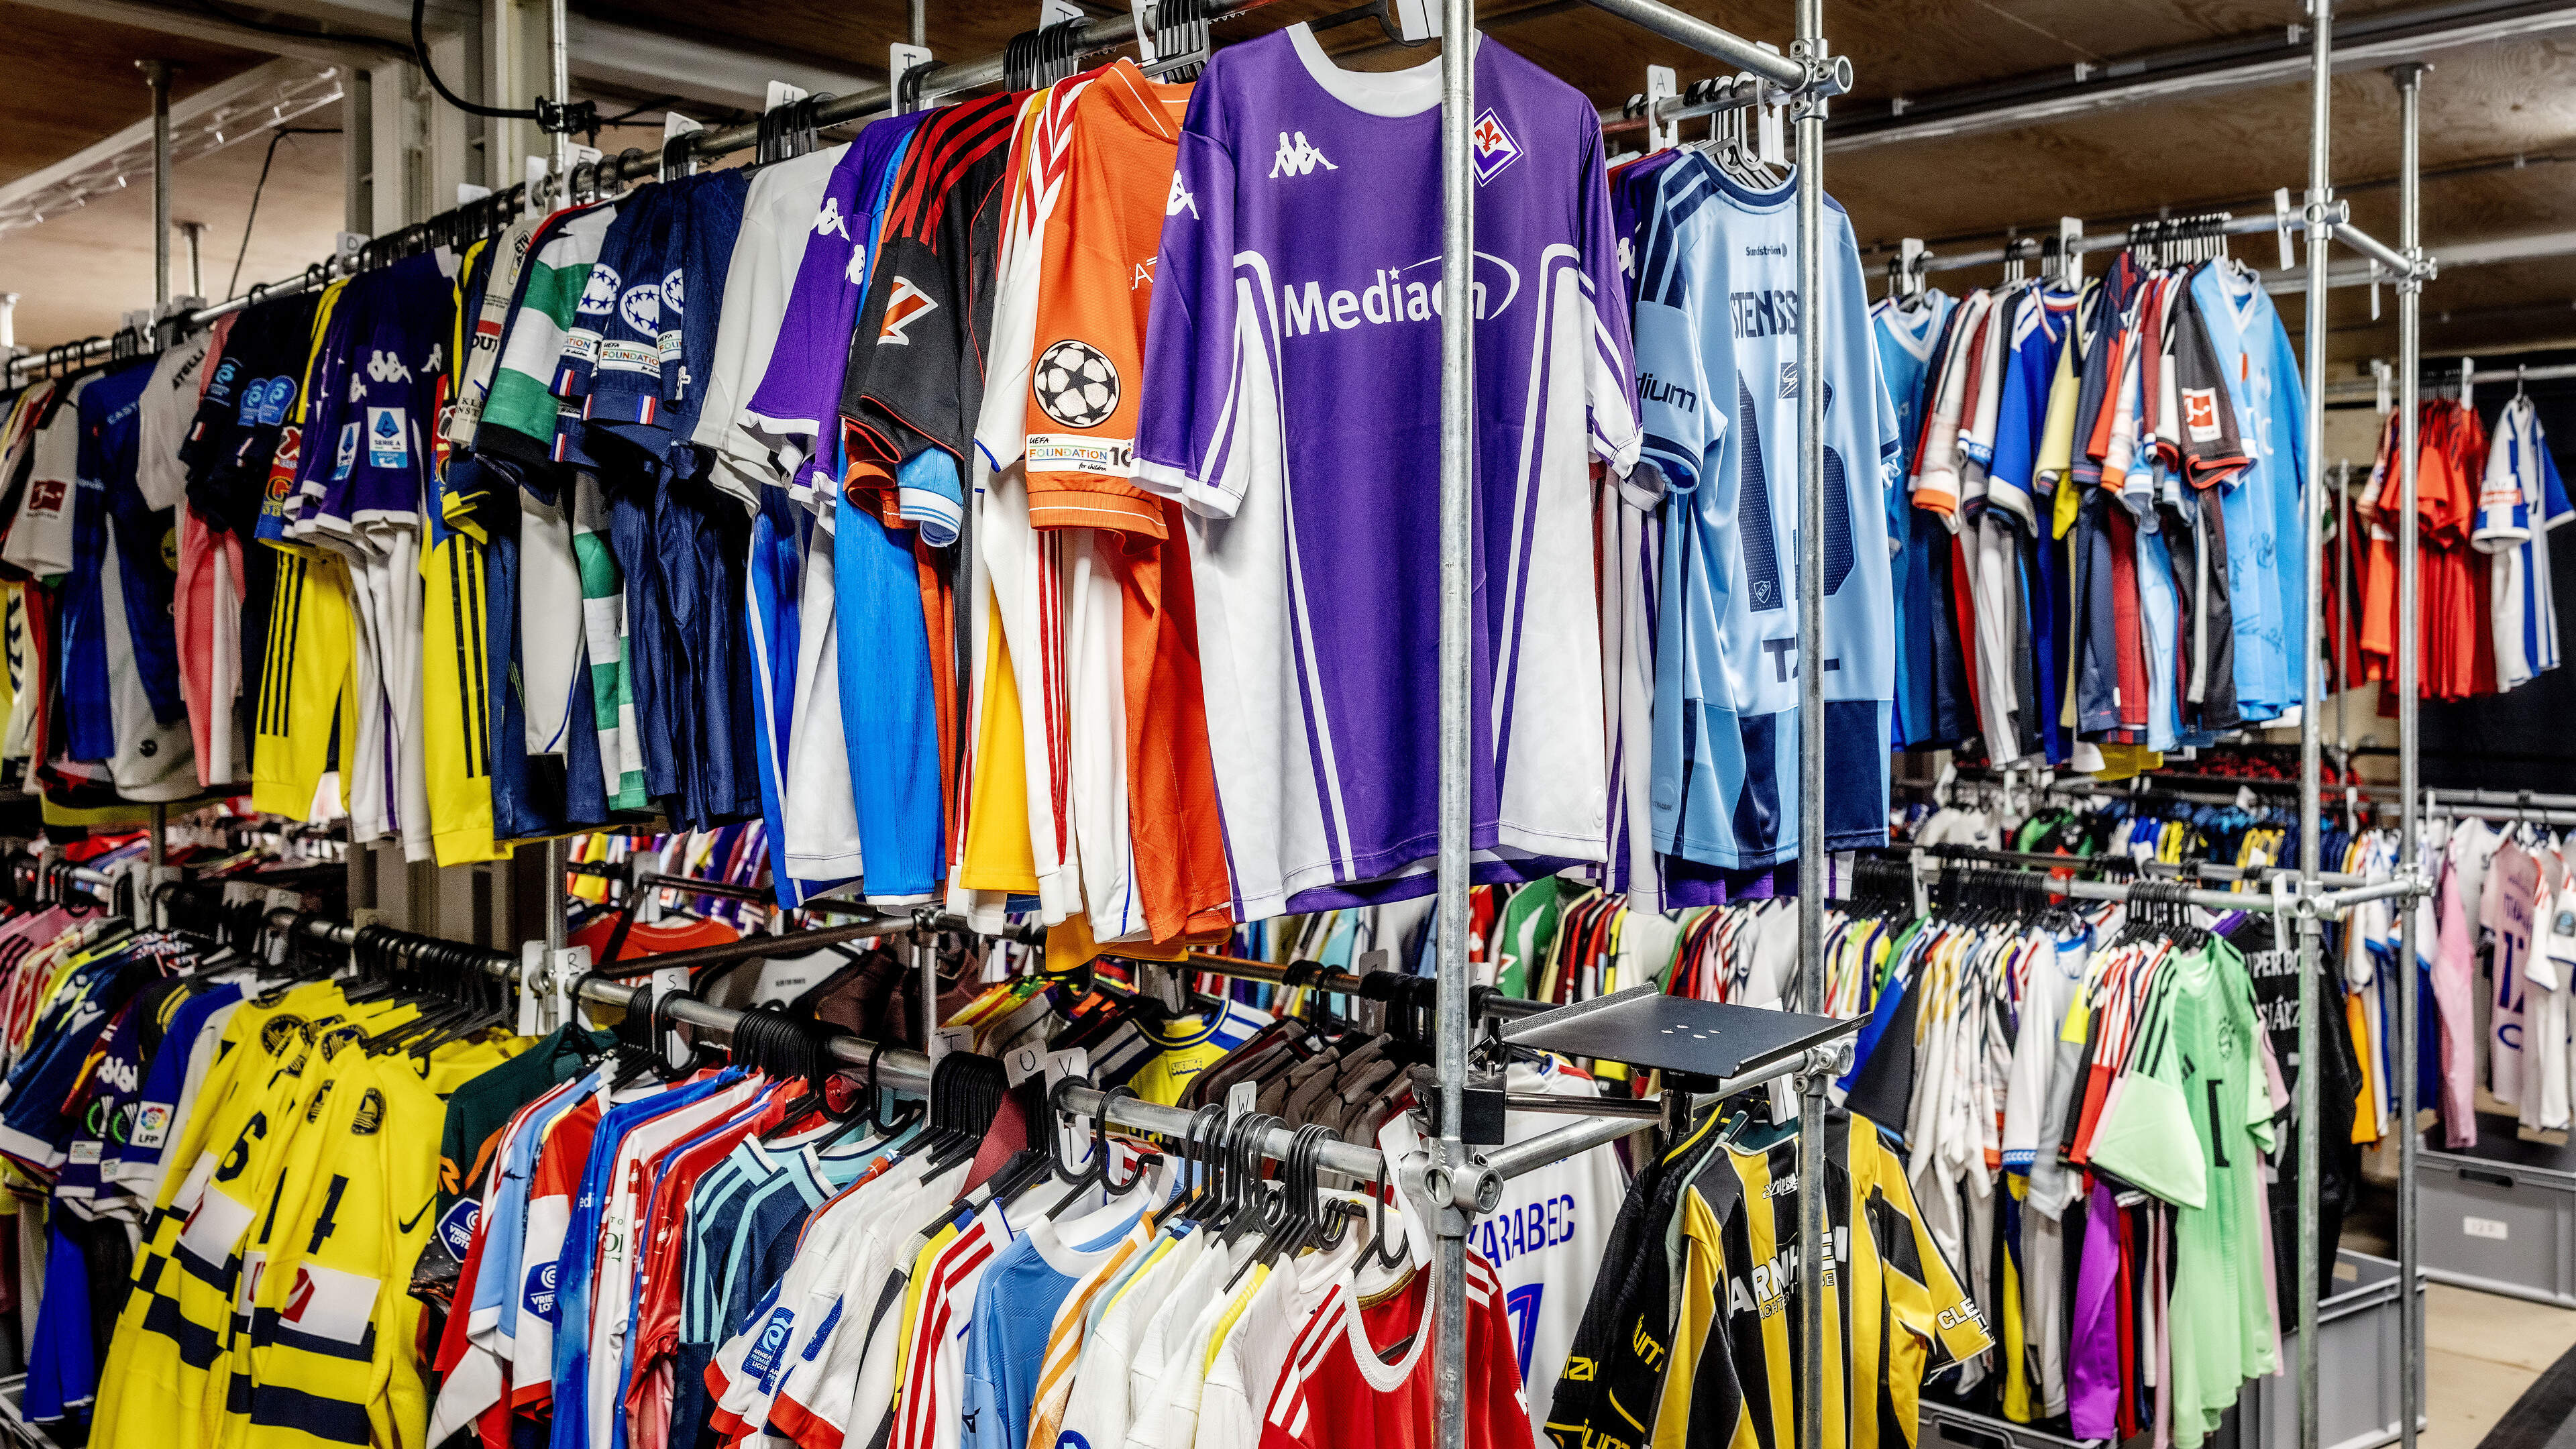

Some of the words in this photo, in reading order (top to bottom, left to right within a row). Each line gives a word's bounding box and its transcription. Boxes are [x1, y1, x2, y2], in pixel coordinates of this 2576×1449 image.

[1656, 72, 1666, 92] A
[1746, 244, 1781, 256] Sundström
[1730, 290, 1798, 339] STENSS
[602, 350, 659, 366] FOUNDATIO
[1029, 437, 1050, 445] UEFA
[1087, 463, 1107, 472] children
[665, 974, 676, 990] S
[1020, 1050, 1036, 1071] U
[1058, 1056, 1073, 1076] V
[753, 1348, 772, 1362] ARKEM
